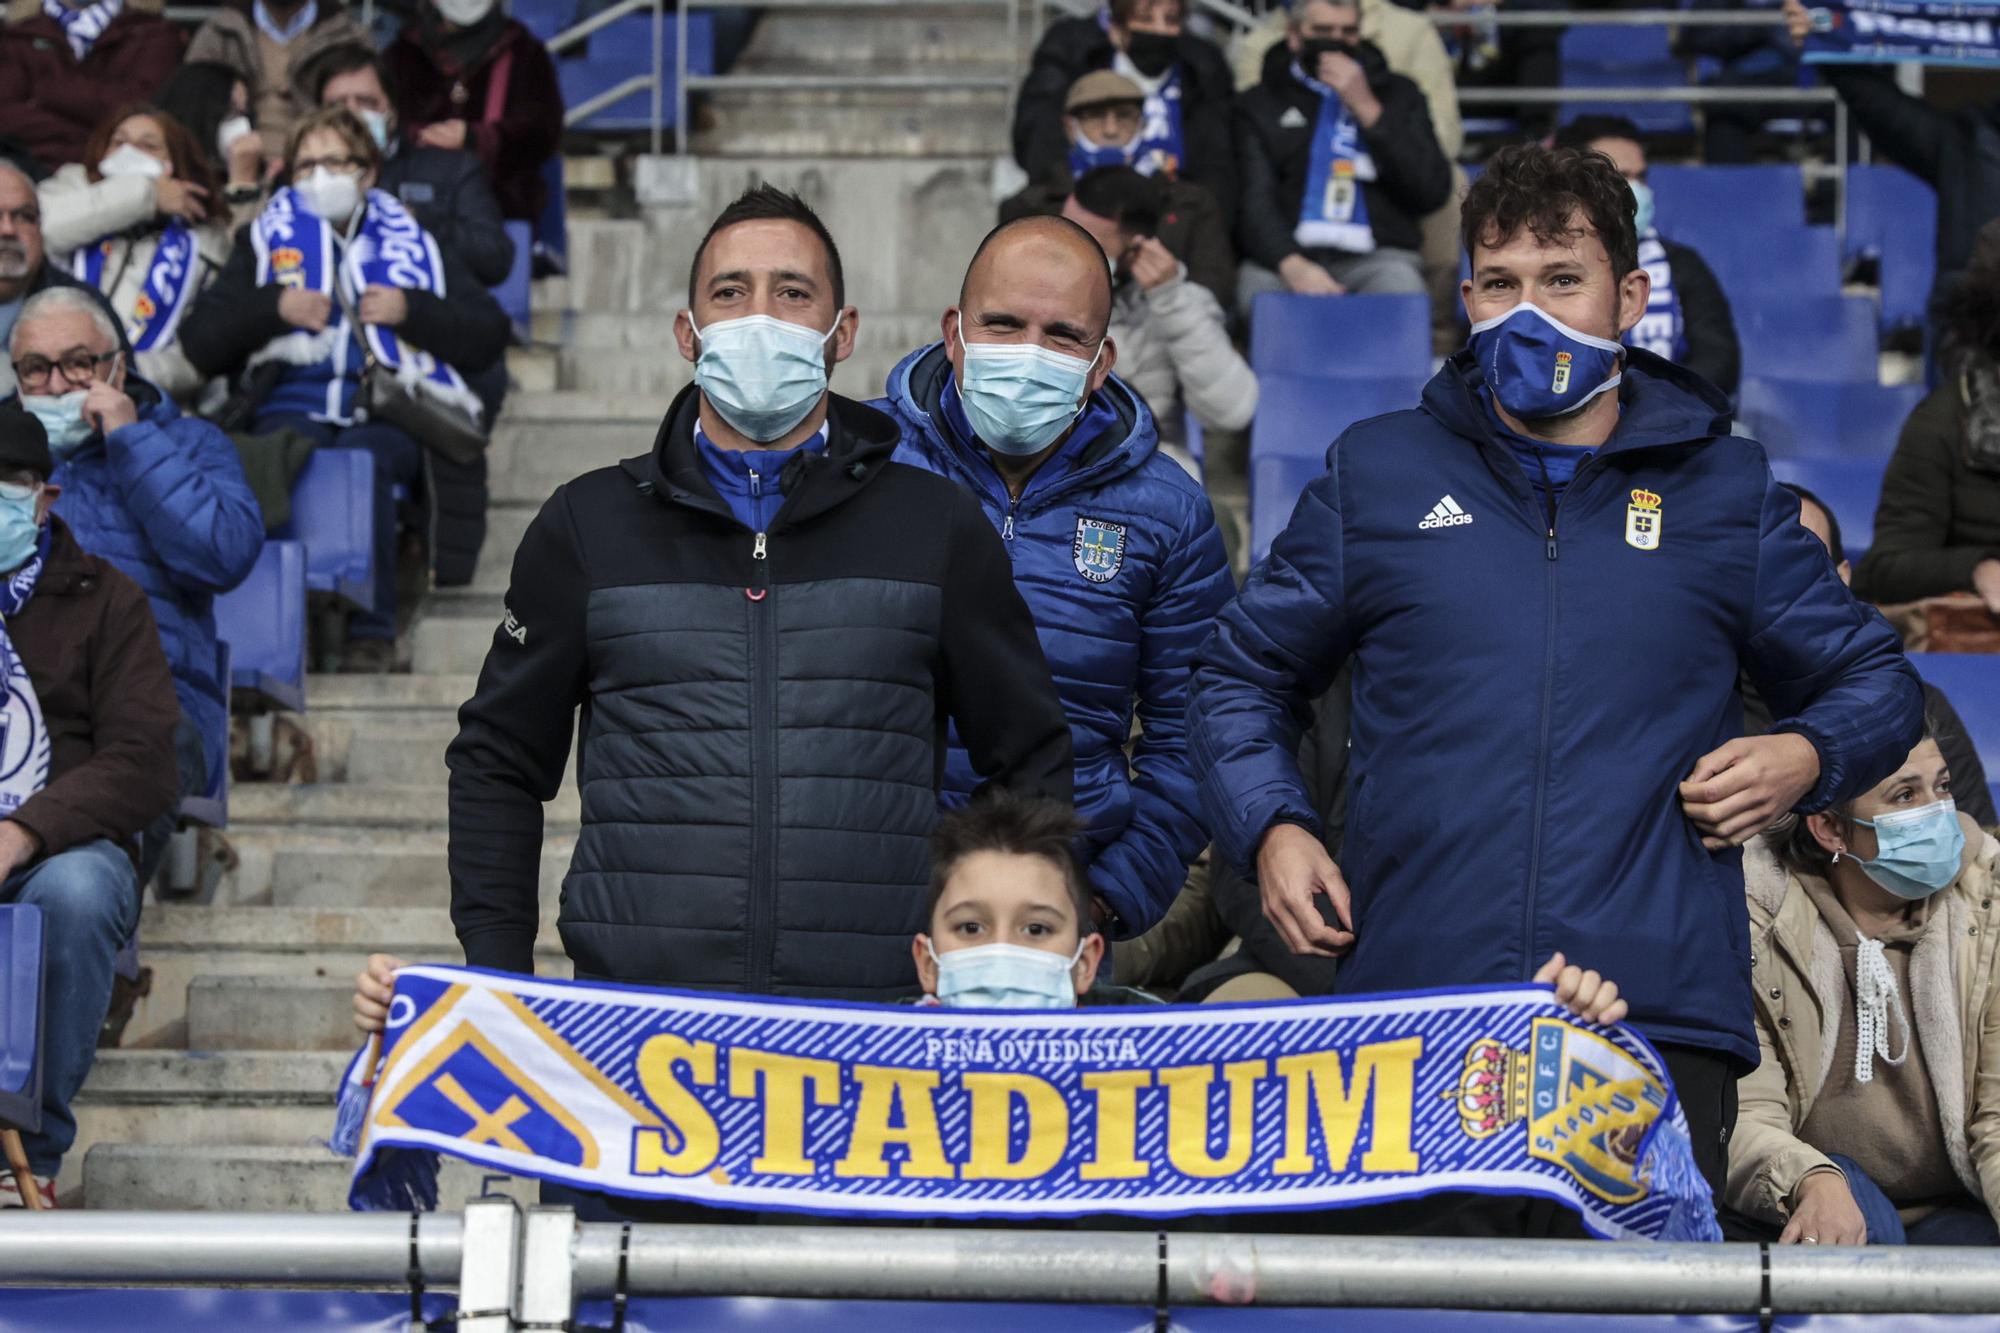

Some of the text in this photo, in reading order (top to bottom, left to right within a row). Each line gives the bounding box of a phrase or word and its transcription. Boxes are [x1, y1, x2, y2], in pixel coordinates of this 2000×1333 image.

[1091, 521, 1122, 533] OVIEDO
[1418, 513, 1473, 530] adidas
[1073, 530, 1083, 559] PEÑA
[1082, 569, 1109, 581] AZUL
[926, 1033, 1139, 1063] PEÑA OVIEDISTA
[635, 1033, 1424, 1179] STADIUM
